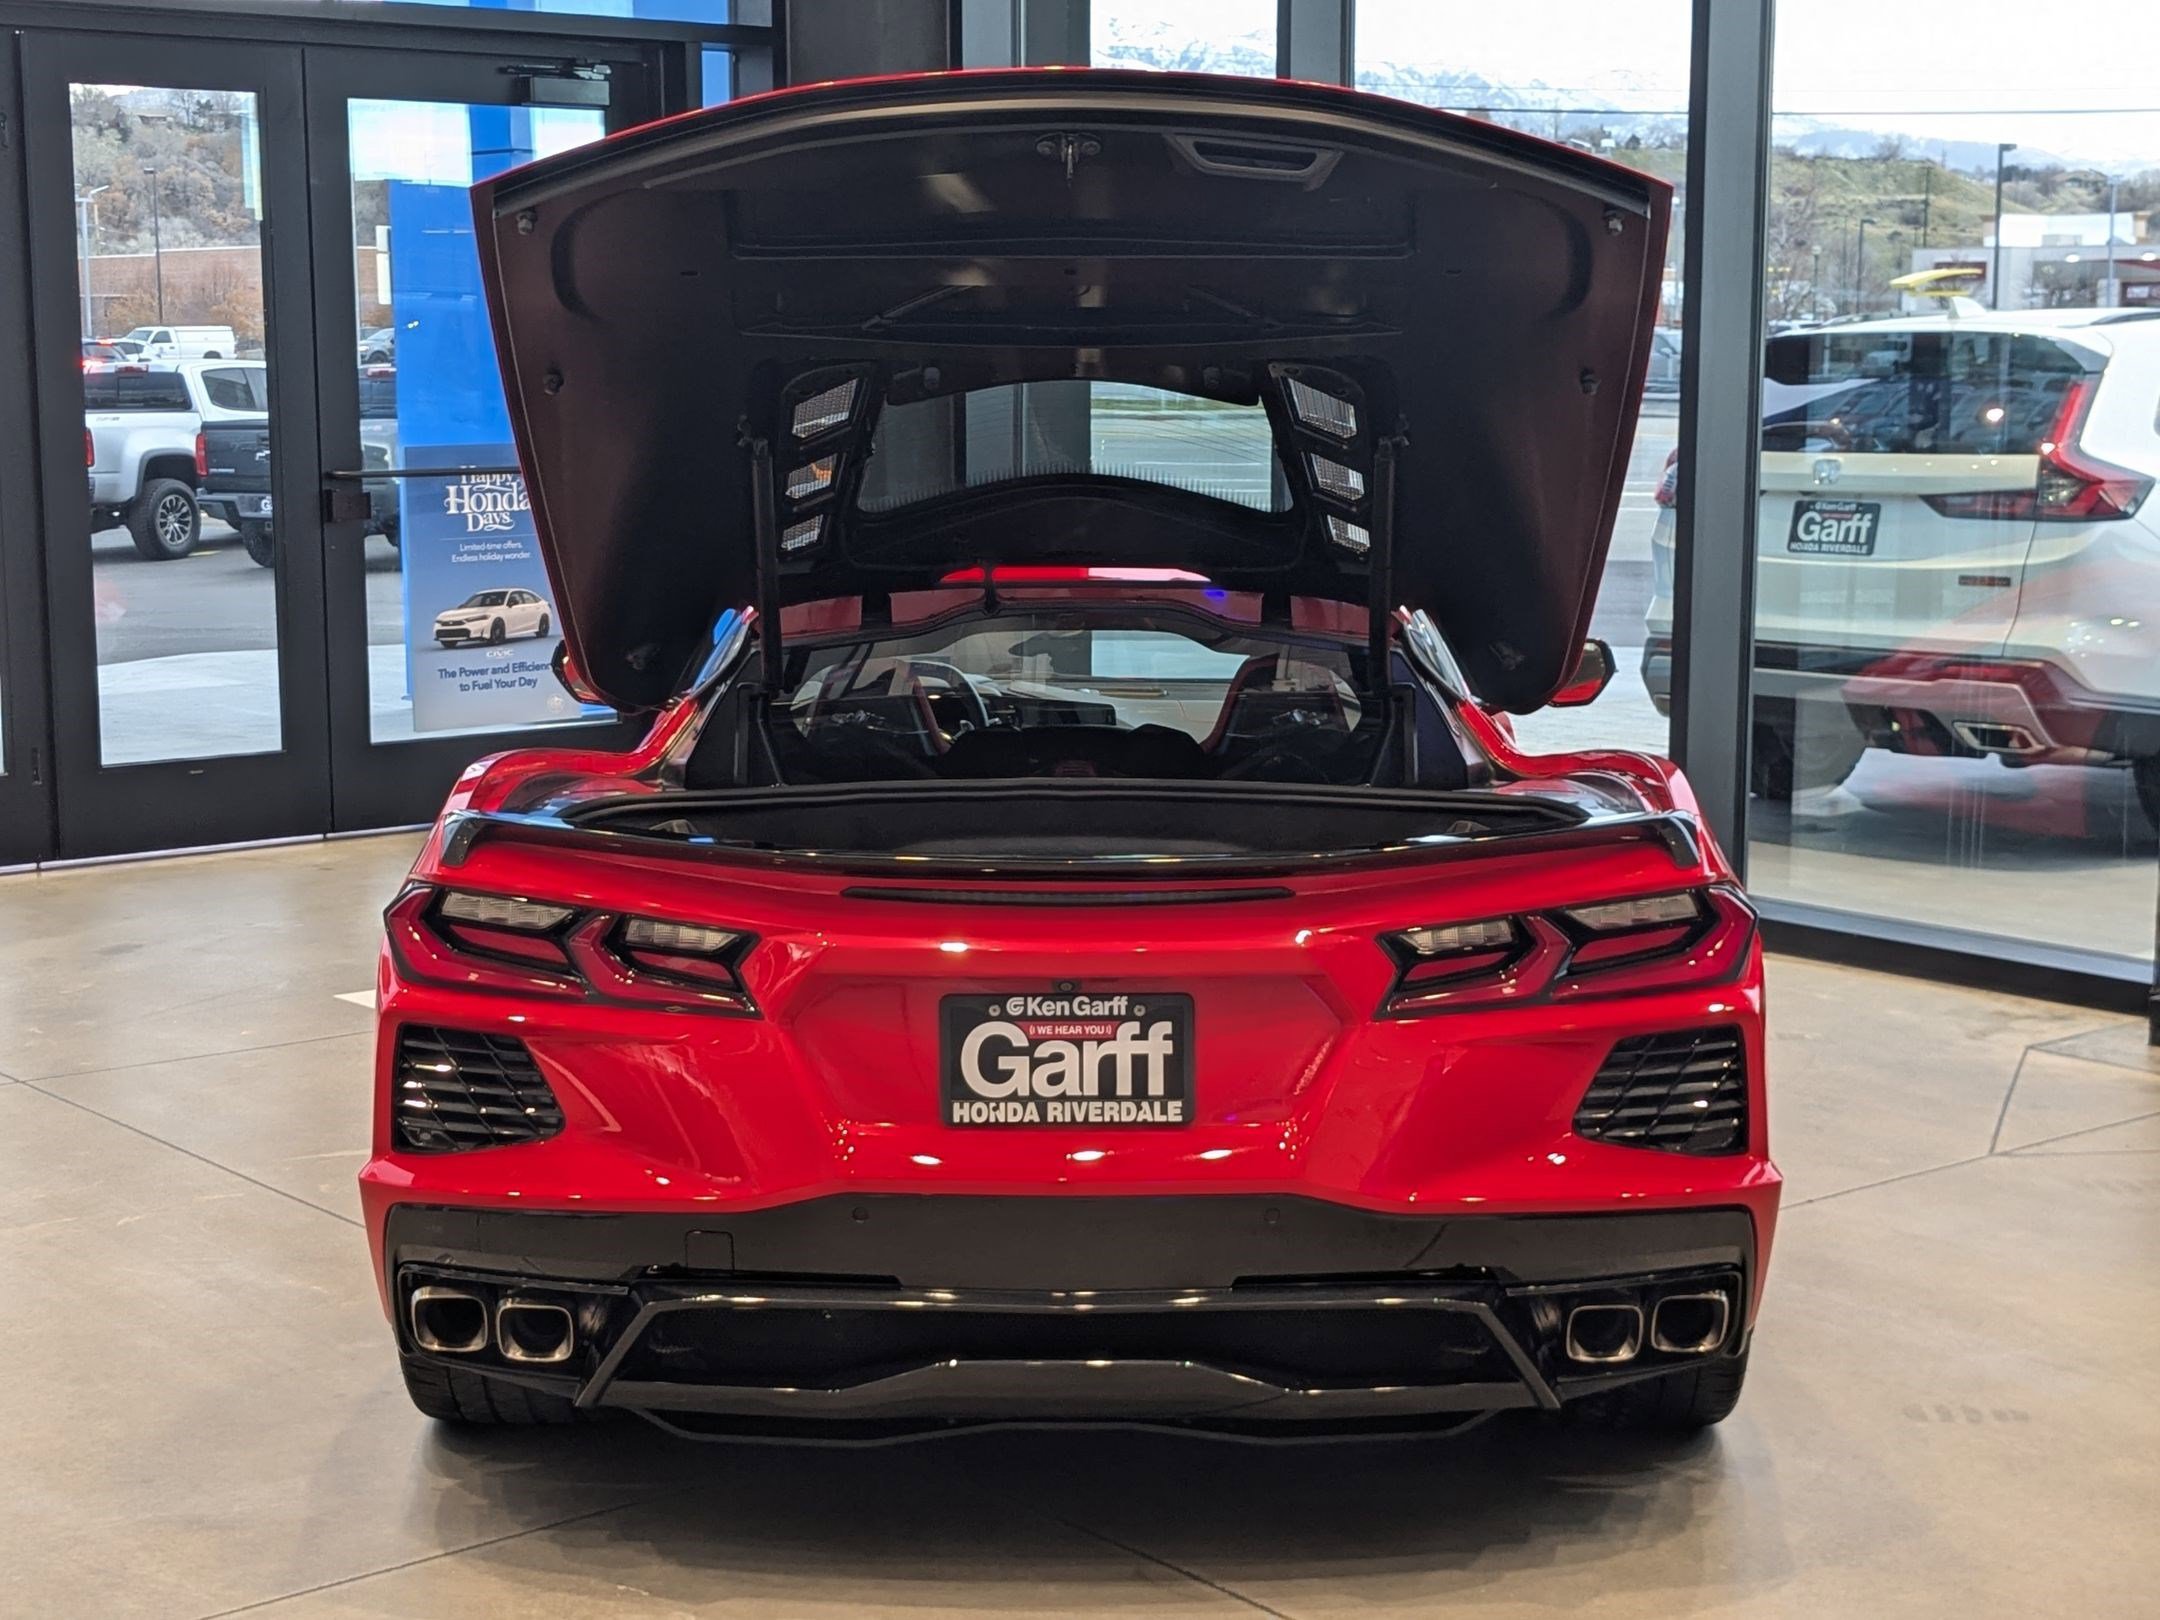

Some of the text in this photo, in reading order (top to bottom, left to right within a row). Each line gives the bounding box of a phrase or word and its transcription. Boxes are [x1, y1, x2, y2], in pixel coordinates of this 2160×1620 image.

[444, 482, 531, 514] Honda
[467, 512, 515, 532] Days
[1797, 511, 1873, 543] Garff
[438, 661, 551, 679] The Power and Efficienc
[459, 677, 538, 692] to Fuel Your Day
[1027, 996, 1070, 1016] Ken
[1072, 996, 1129, 1016] Garff
[1037, 1024, 1106, 1035] WE HEAR YOU
[961, 1021, 1173, 1098] Garff
[953, 1101, 1182, 1123] HONDA RIVERDALE
